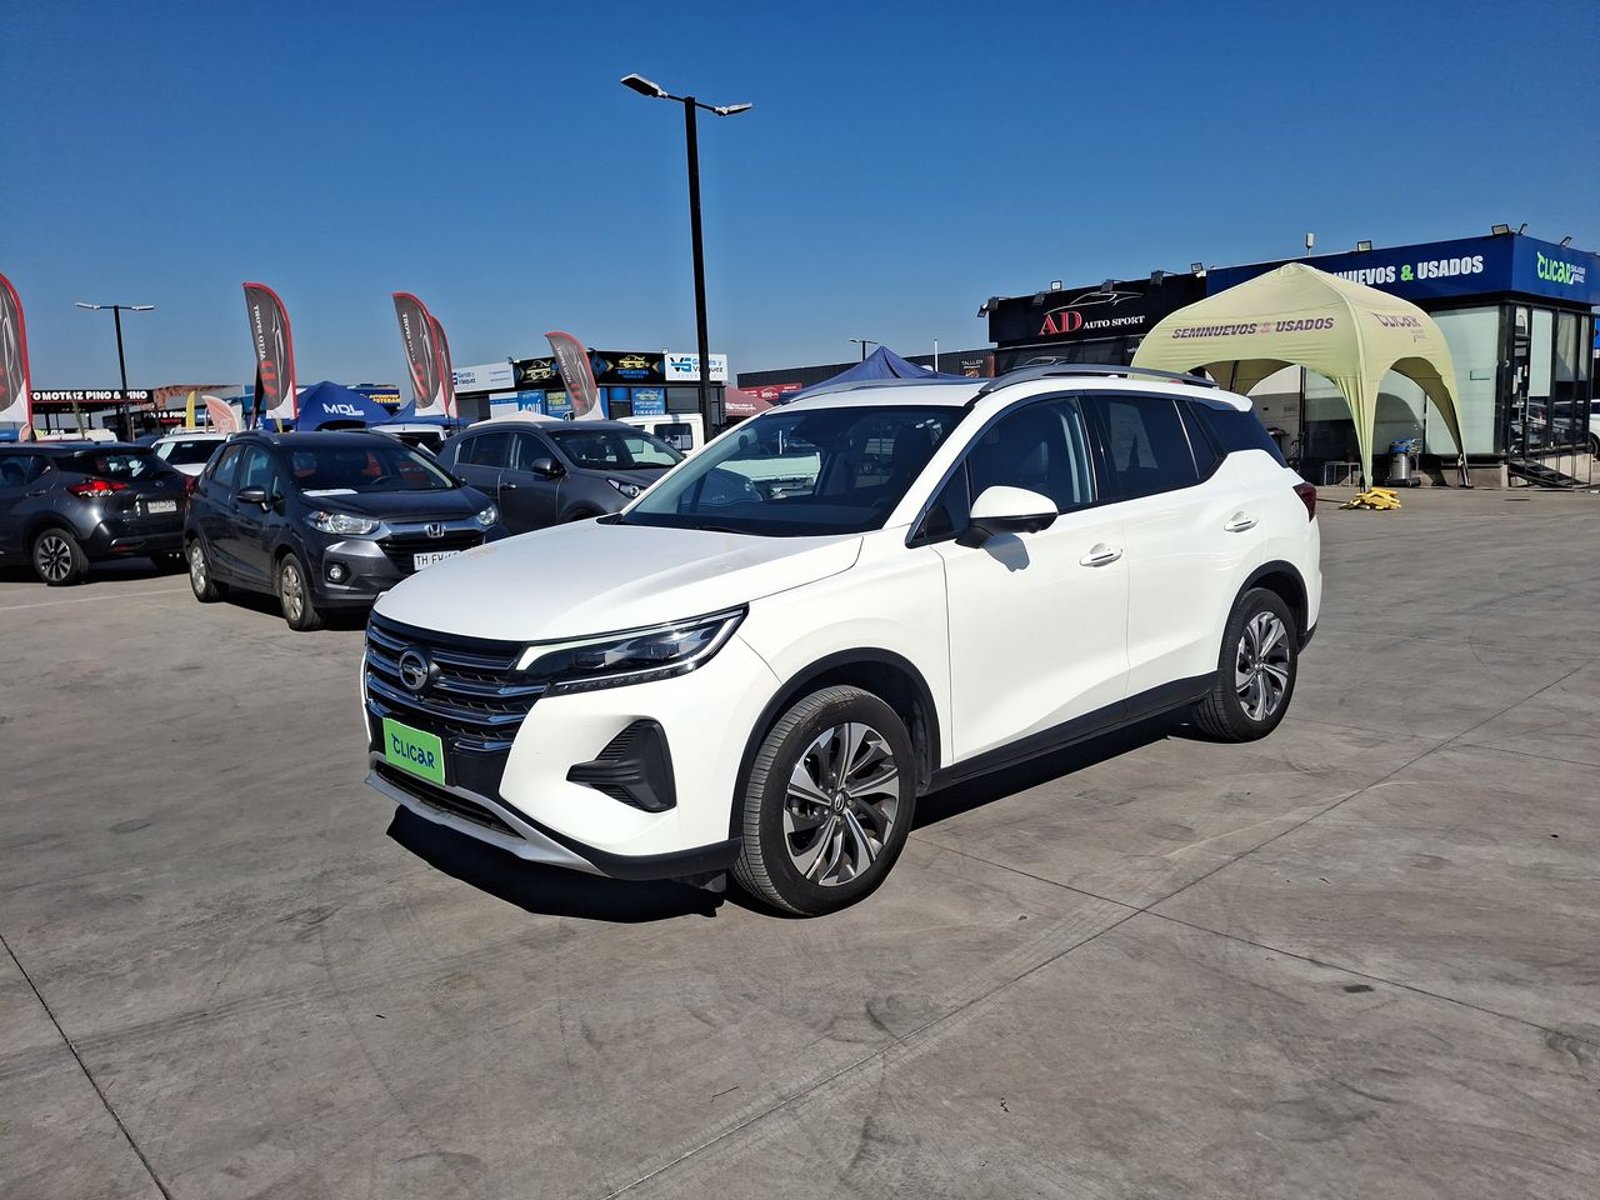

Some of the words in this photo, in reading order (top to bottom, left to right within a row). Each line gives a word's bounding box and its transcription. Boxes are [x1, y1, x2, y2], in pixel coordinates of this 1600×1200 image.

[1401, 265, 1413, 281] &
[1417, 255, 1483, 280] USADOS
[1039, 311, 1082, 335] AD
[1083, 320, 1110, 330] AUTO
[1112, 315, 1145, 326] SPORT
[1172, 323, 1257, 339] SEMINUEVOS
[1275, 317, 1334, 332] USADOS
[86, 391, 112, 399] PINO
[114, 391, 120, 399] &
[126, 391, 148, 399] INO
